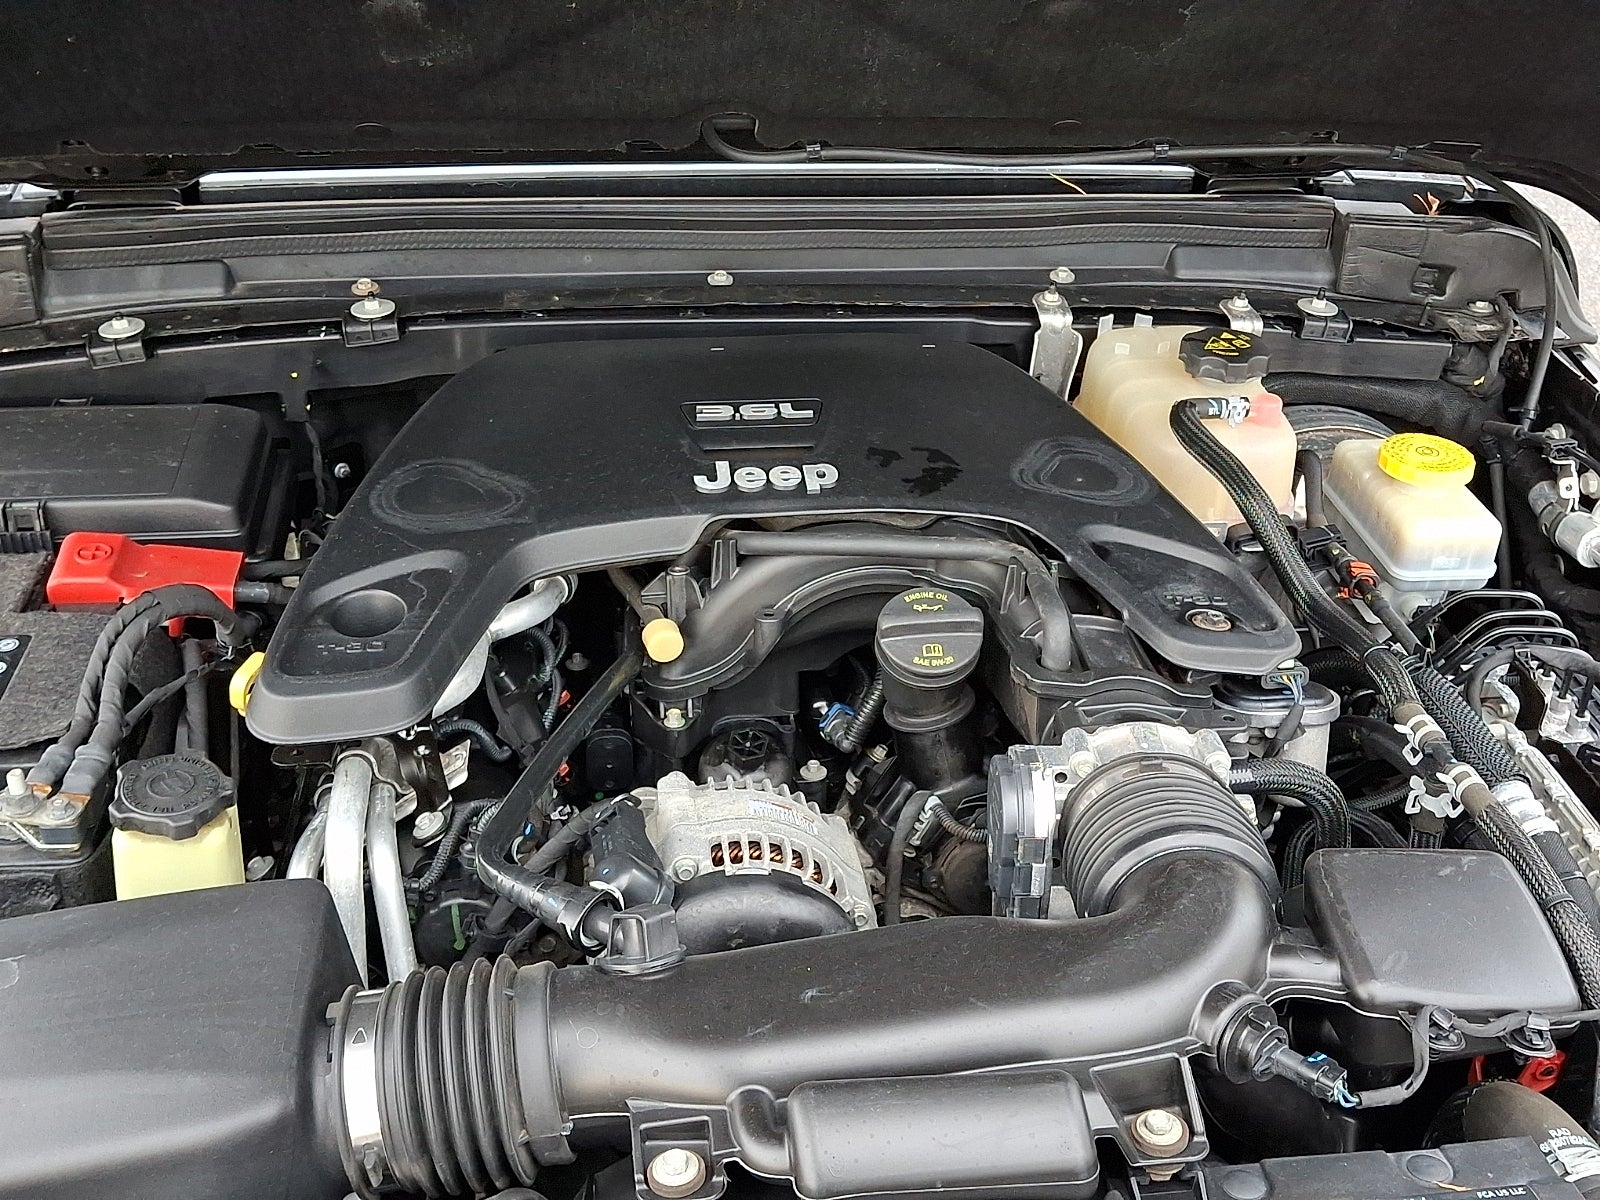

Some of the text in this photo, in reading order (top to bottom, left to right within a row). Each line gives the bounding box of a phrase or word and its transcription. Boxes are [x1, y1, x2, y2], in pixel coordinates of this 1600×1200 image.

[695, 403, 814, 422] 3.6L
[693, 460, 839, 495] Jeep
[904, 591, 949, 602] ENGINE OIL
[912, 656, 930, 667] SAE
[1548, 1127, 1572, 1139] RAD
[1496, 1188, 1510, 1197] US
[1508, 1186, 1527, 1195] LLC
